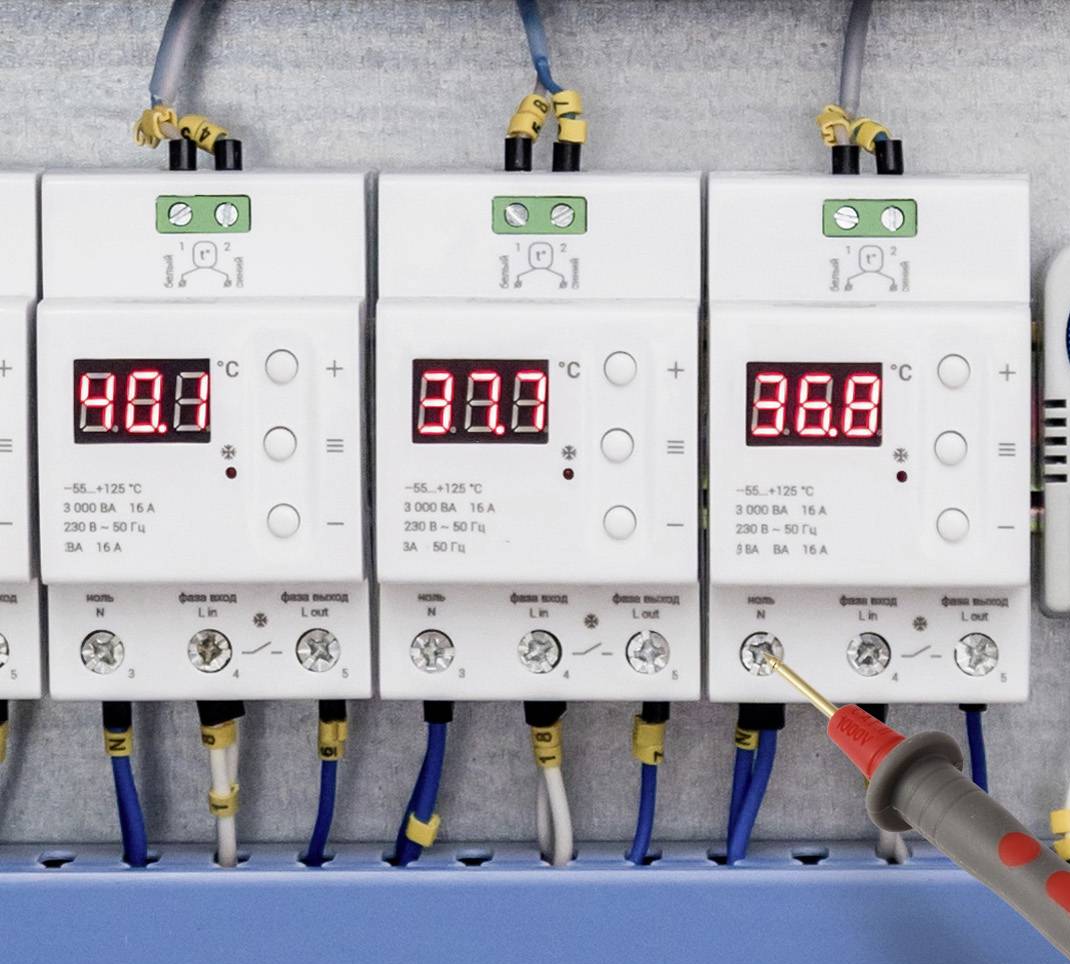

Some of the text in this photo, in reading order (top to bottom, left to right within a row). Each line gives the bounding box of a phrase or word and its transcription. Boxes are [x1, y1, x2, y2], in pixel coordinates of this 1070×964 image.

[63, 502, 71, 513] 3
[74, 502, 97, 513] 000
[130, 502, 145, 513] 16
[404, 502, 411, 513] 3
[414, 502, 438, 513] 000
[470, 502, 485, 513] 16
[735, 504, 743, 516] 3
[745, 504, 769, 516] 000
[802, 504, 816, 516] 16
[63, 521, 86, 533] 230
[112, 521, 128, 533] 50
[404, 520, 426, 532] 230
[452, 520, 468, 532] 50
[735, 523, 758, 535] 230
[784, 523, 799, 535] 50
[97, 541, 111, 553] 16
[432, 541, 448, 552] 50
[802, 544, 817, 555] 16
[311, 608, 329, 618] out
[641, 609, 659, 619] out
[970, 611, 988, 621] out
